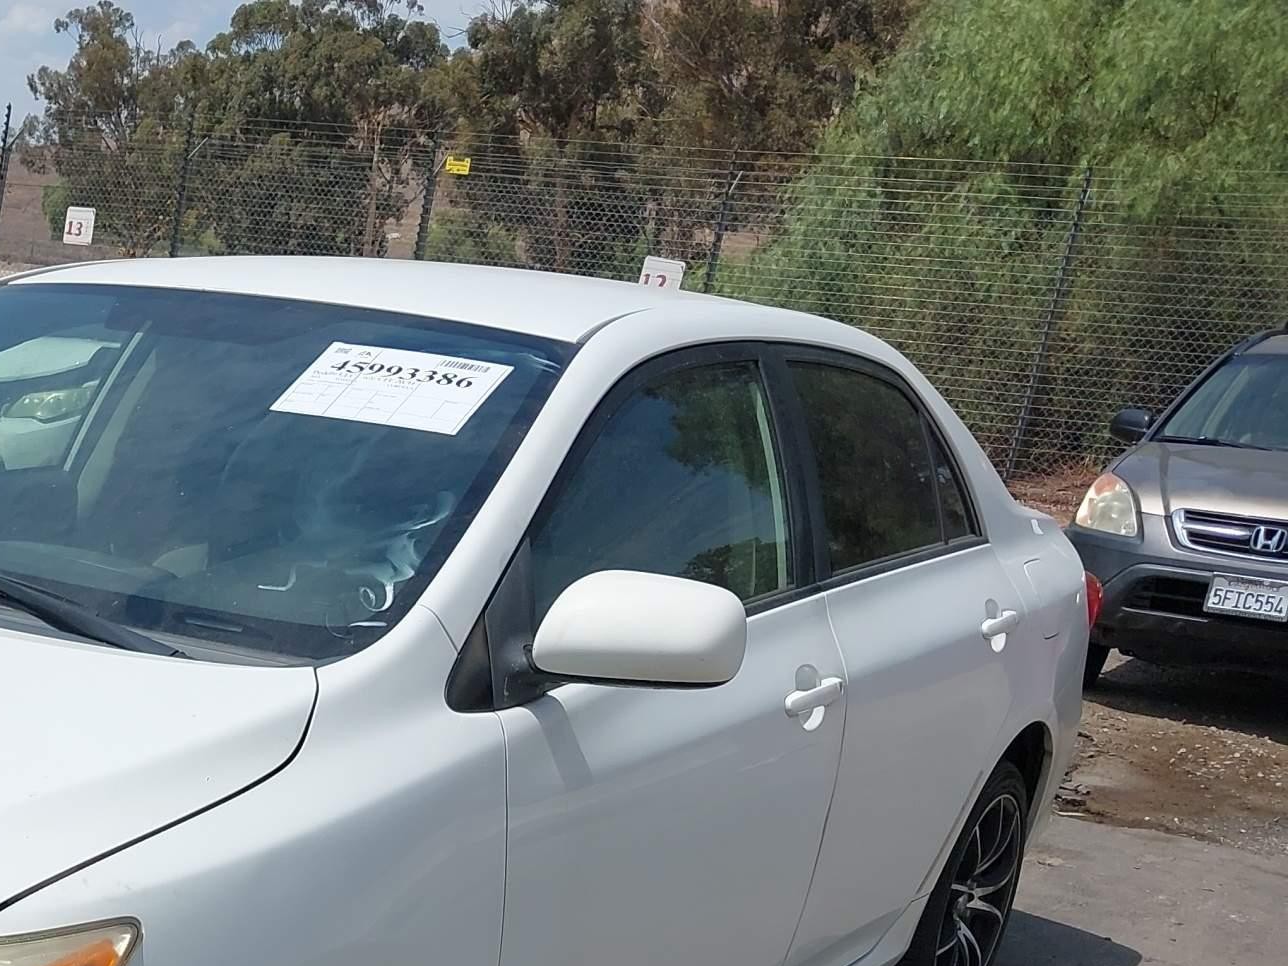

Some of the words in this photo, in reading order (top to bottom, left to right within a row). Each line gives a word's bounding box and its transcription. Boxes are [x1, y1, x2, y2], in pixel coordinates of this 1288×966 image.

[66, 221, 83, 236] 13
[330, 359, 479, 389] 45993386
[1212, 587, 1283, 615] 5FIC554
